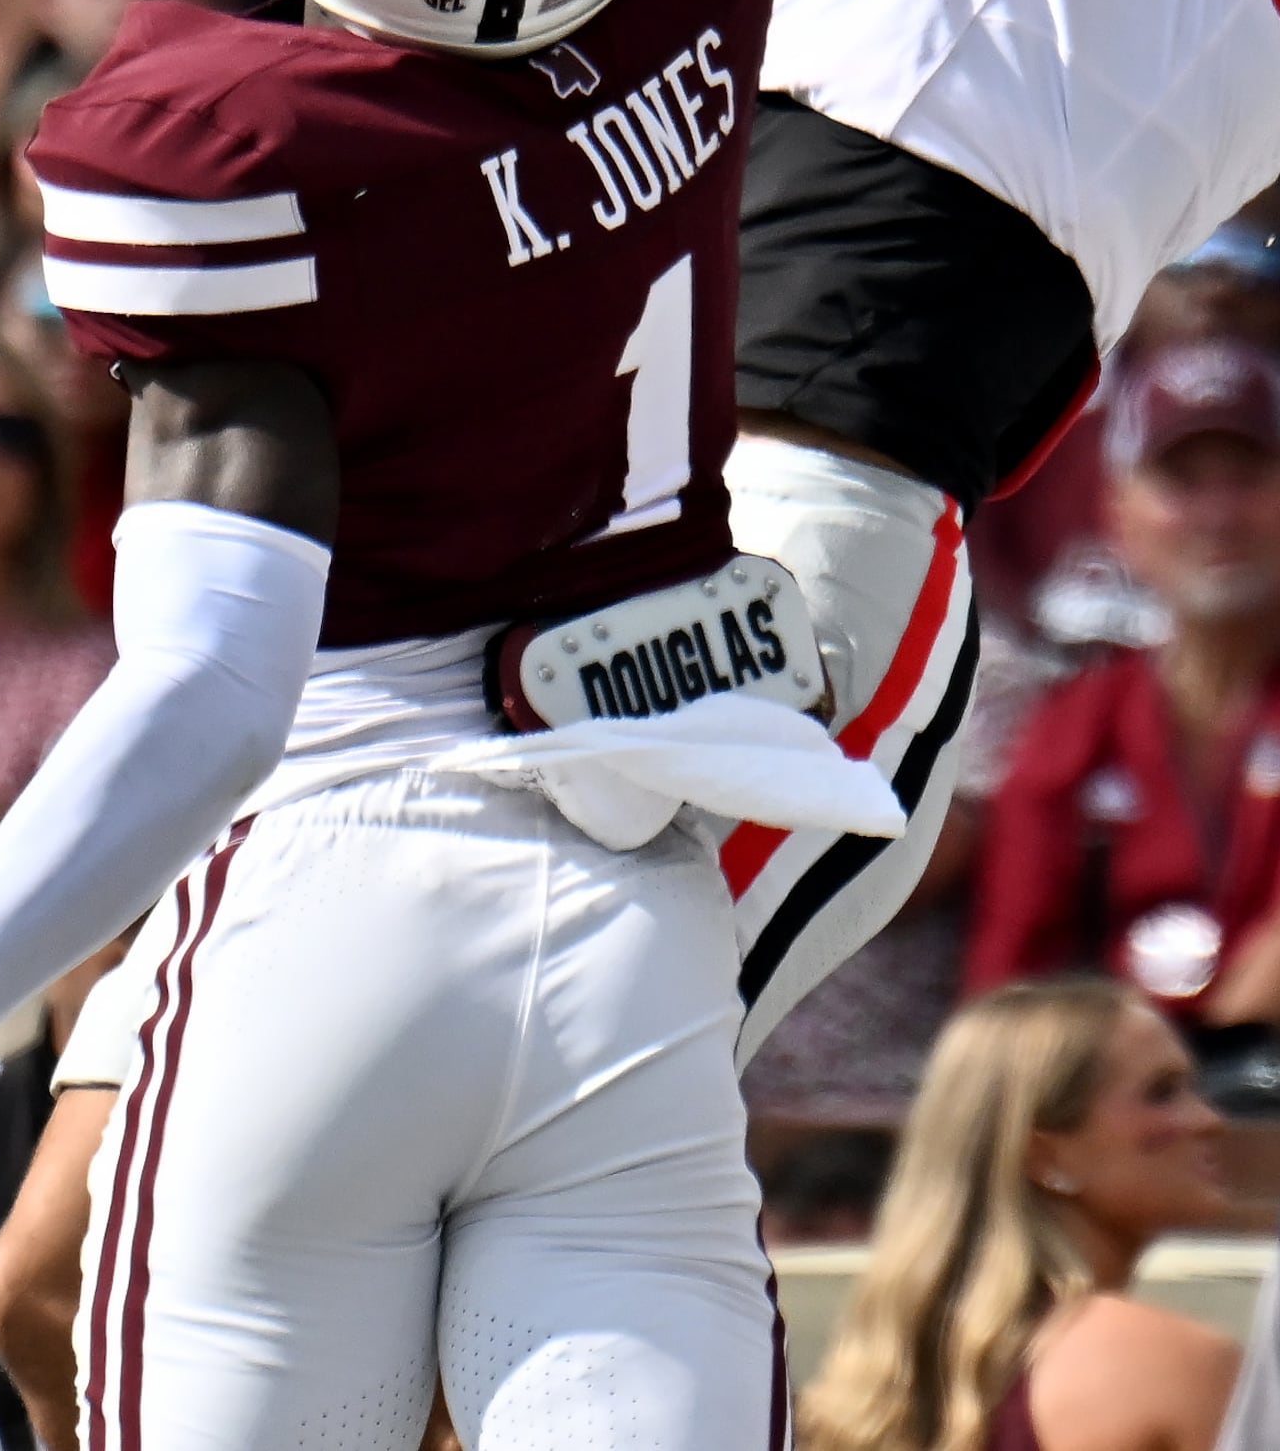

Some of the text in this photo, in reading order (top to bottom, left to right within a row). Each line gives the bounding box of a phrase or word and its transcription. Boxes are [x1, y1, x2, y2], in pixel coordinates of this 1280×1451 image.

[480, 27, 737, 268] K. JONES
[580, 252, 694, 548] 1
[578, 597, 787, 720] DOUGLAS
